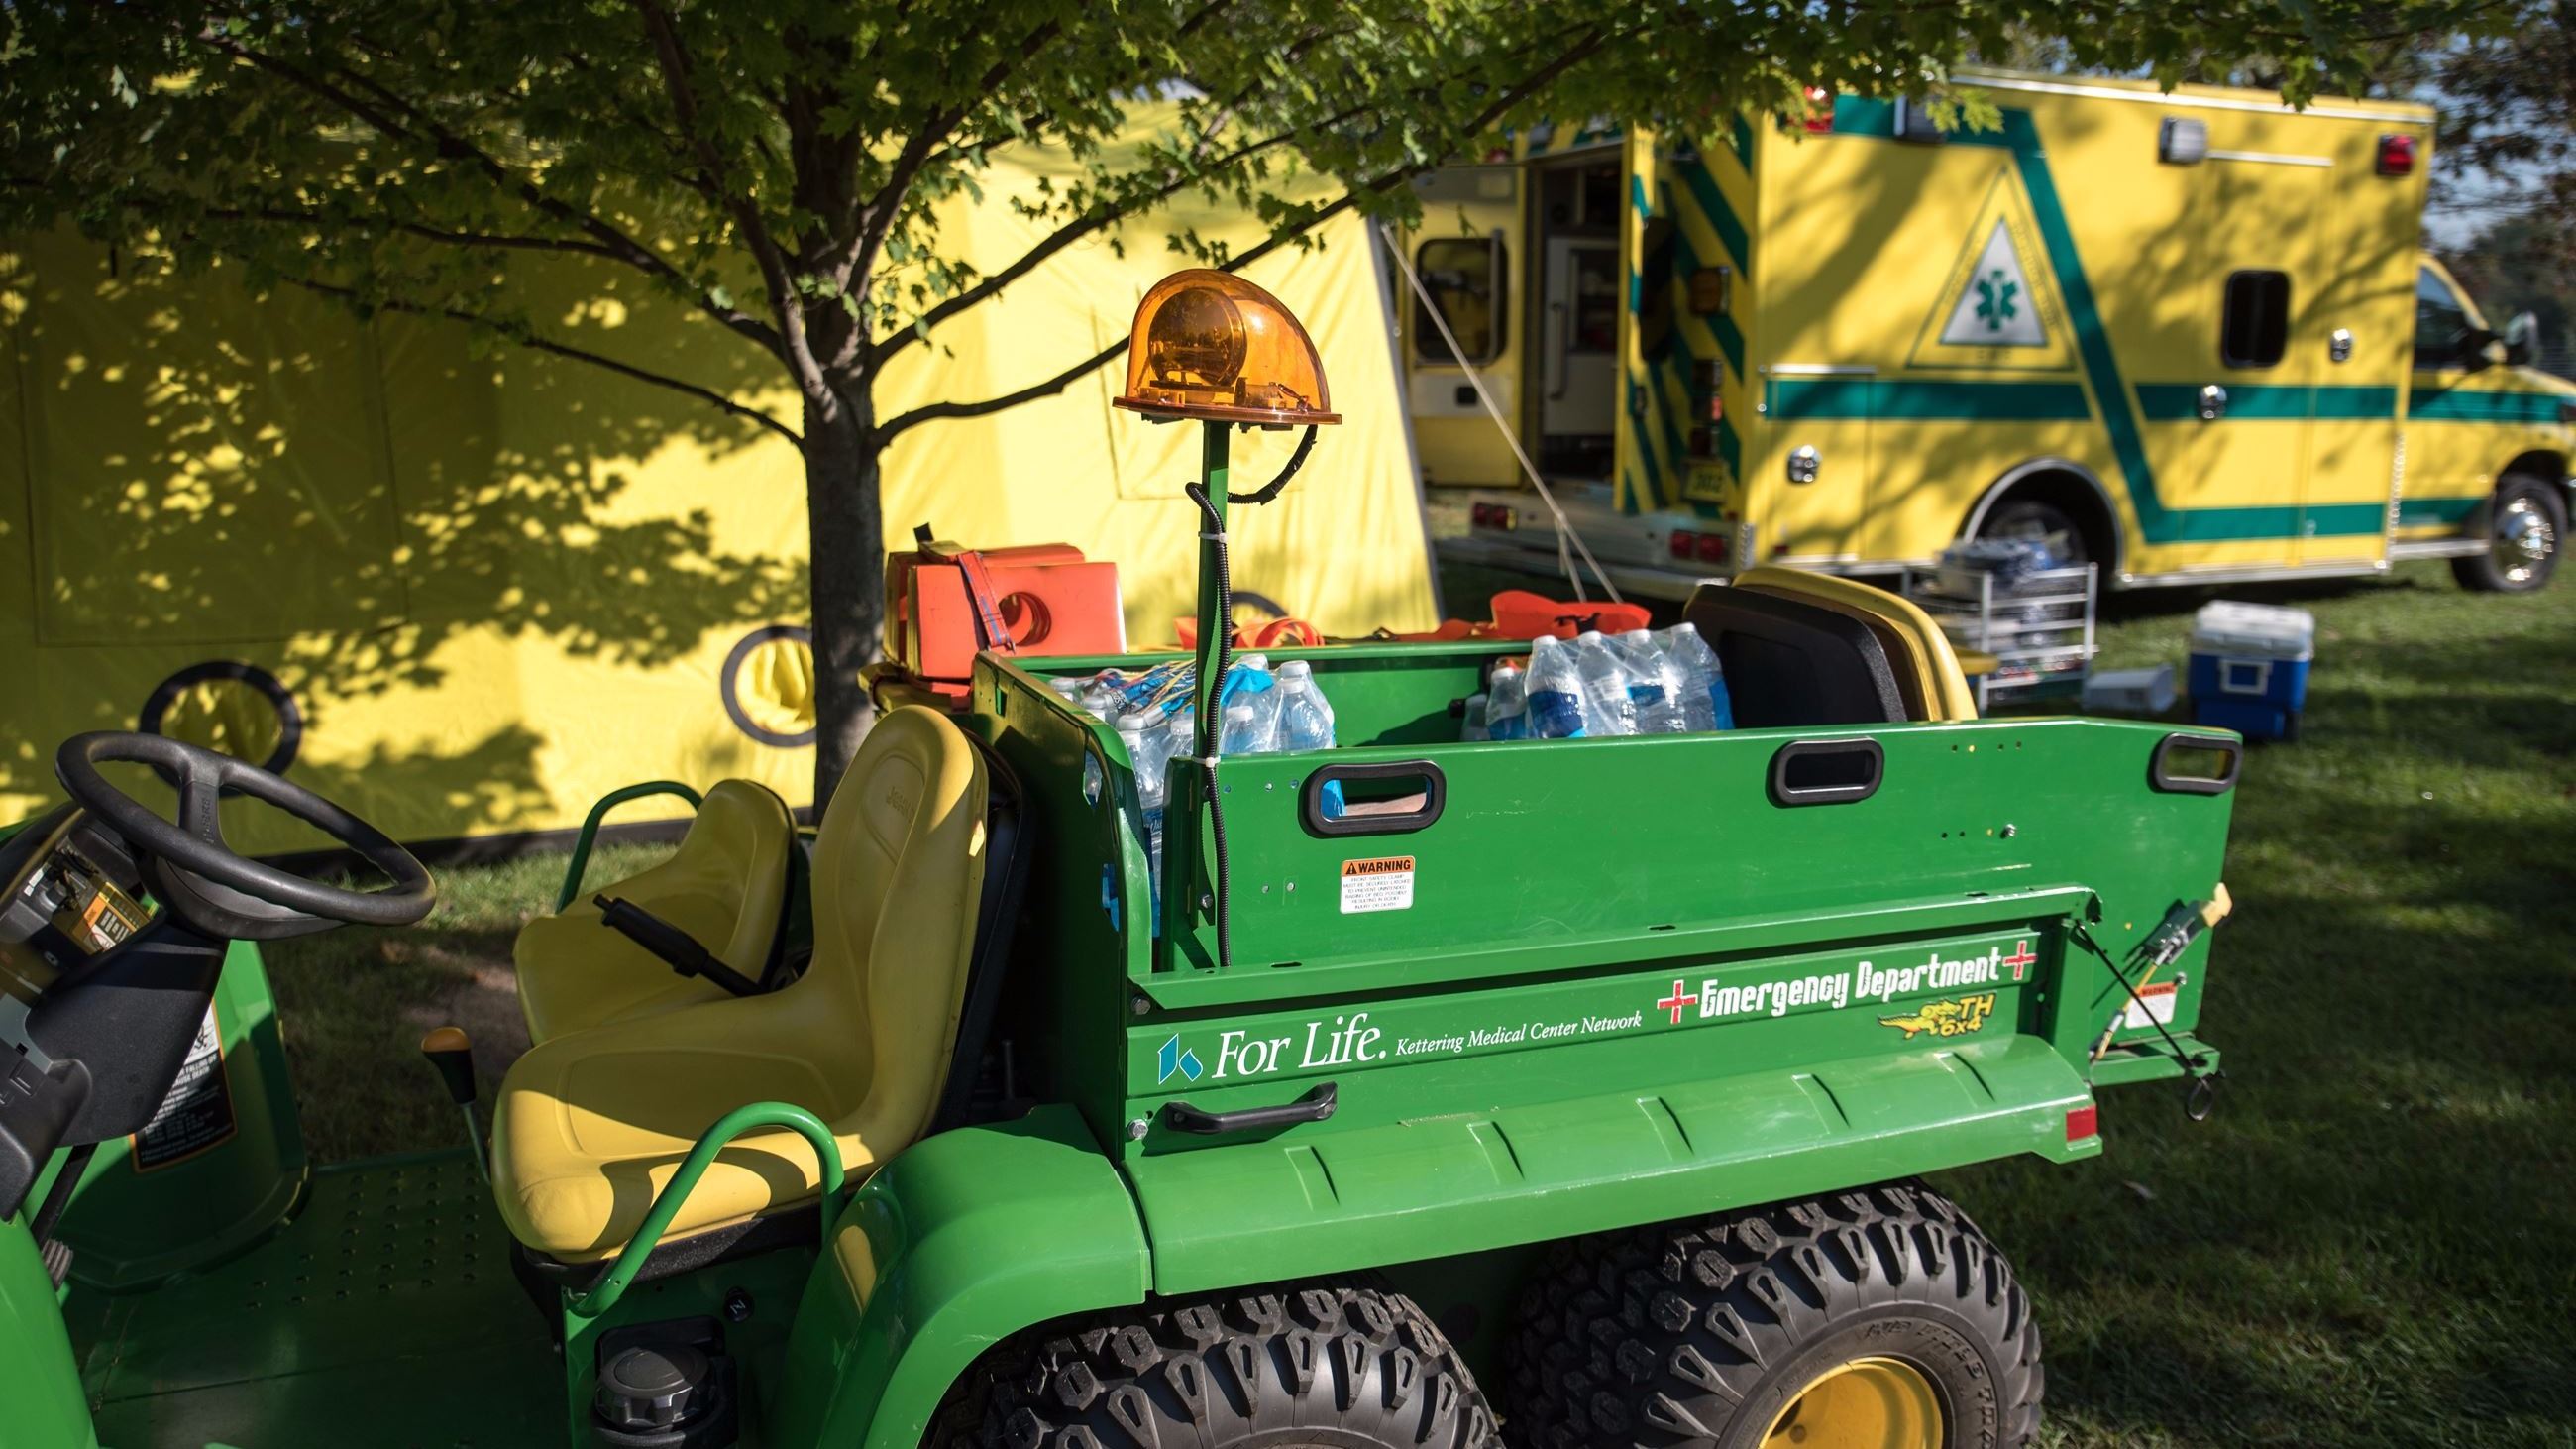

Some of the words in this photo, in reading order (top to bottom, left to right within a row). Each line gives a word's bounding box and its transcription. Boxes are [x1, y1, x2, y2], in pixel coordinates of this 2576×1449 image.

[1358, 860, 1411, 873] WARNING
[1700, 973, 1850, 1018] Emergency
[1856, 947, 2001, 1003] Department
[1959, 993, 1995, 1019] TH
[1395, 1033, 1464, 1056] Kettering
[1467, 1023, 1527, 1047] Medical
[1530, 1021, 1578, 1040] Center
[1580, 1010, 1643, 1034] Network
[1939, 1014, 1982, 1037] 6x4
[1212, 1031, 1292, 1079] For
[1298, 1013, 1387, 1068] Life.
